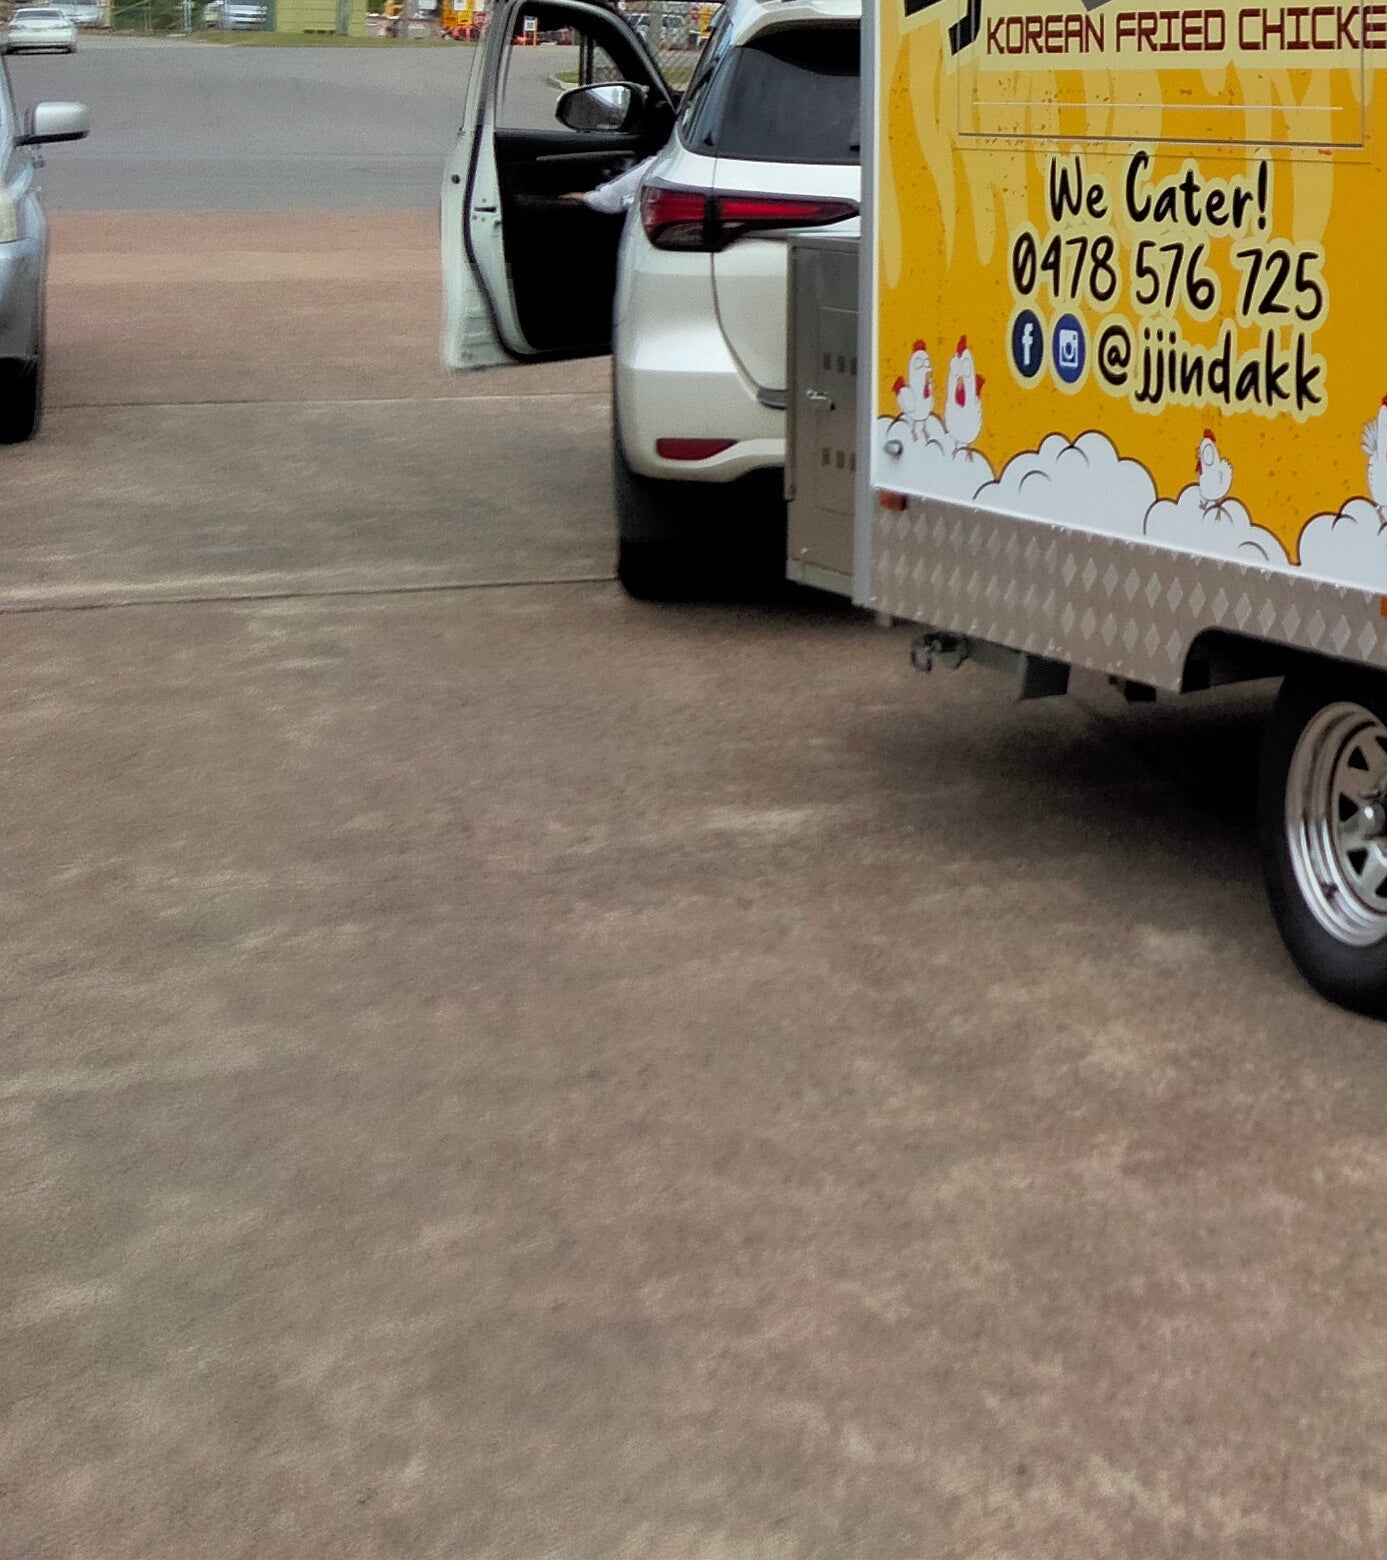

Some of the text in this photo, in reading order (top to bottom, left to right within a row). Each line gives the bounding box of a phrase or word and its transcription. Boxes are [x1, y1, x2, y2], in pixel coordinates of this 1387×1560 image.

[986, 12, 1104, 55] KOREAN
[1116, 9, 1226, 52] FRIED
[1049, 150, 1268, 230] We Cater!
[1013, 231, 1323, 321] 0478 576 725
[1098, 325, 1322, 411] @jjindakk
